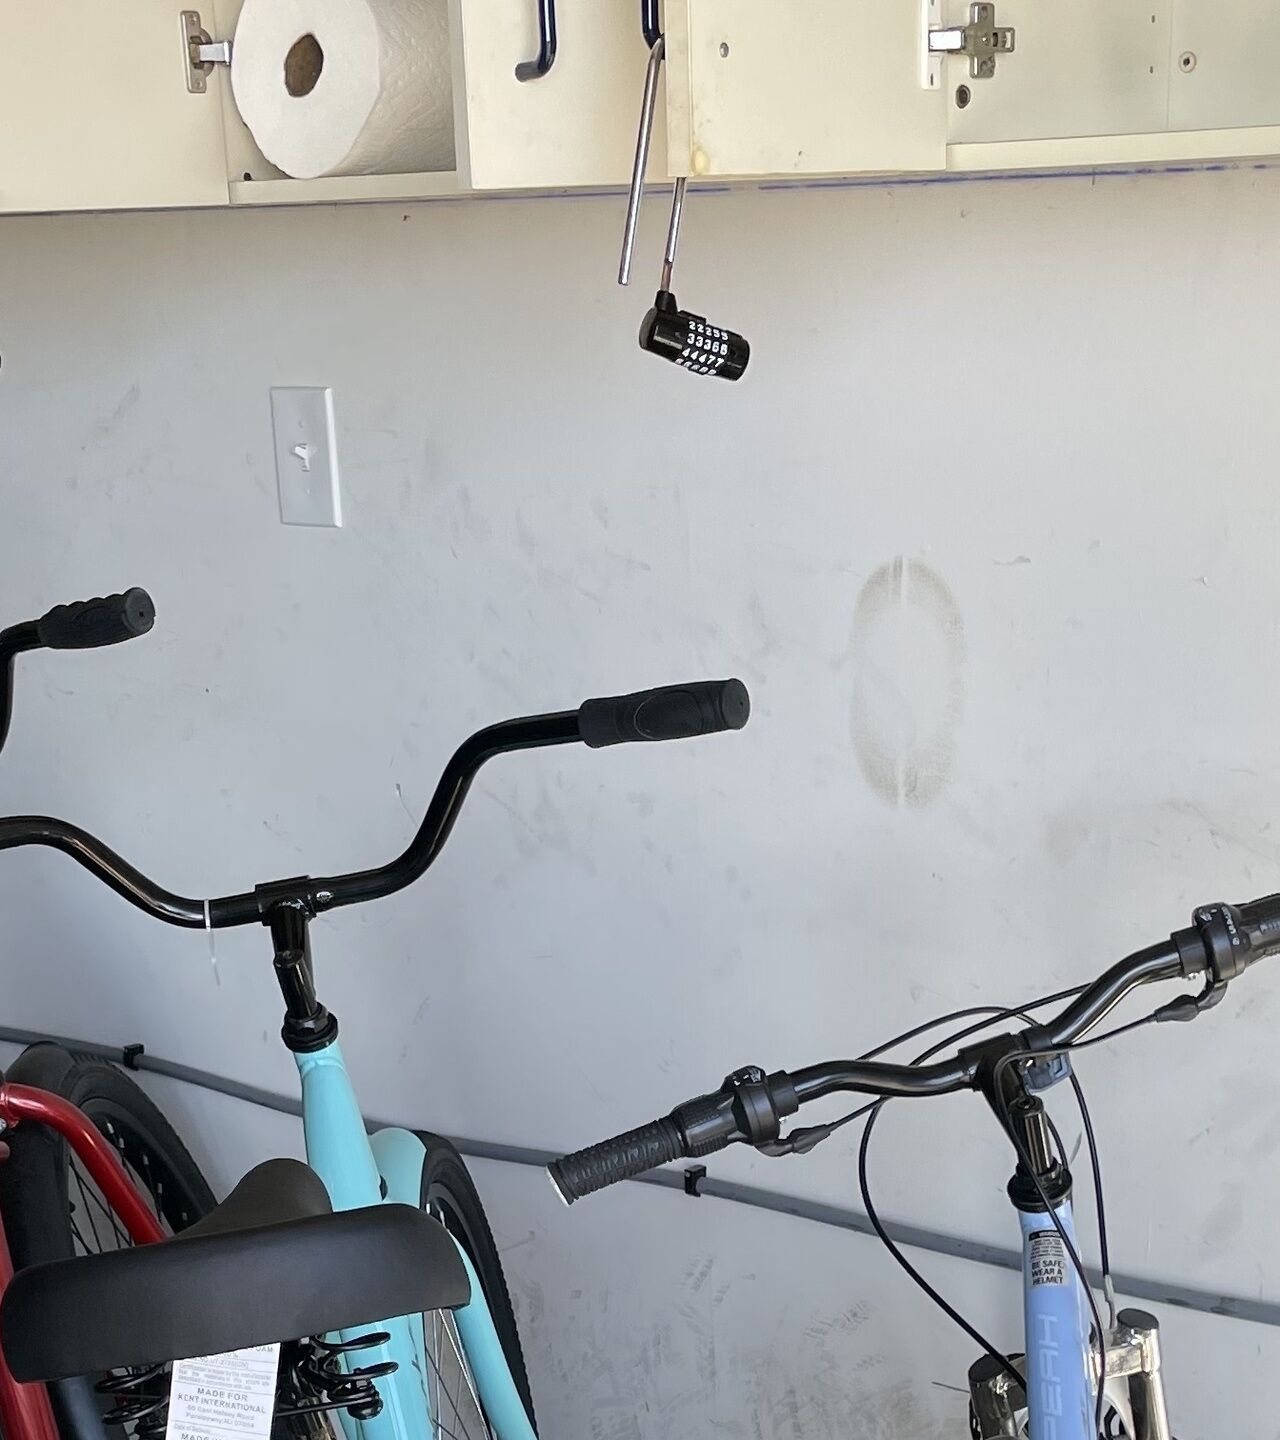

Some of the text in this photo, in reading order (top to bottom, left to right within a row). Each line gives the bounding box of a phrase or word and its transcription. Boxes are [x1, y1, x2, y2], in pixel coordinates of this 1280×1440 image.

[1042, 1259, 1064, 1268] SAFE
[1031, 1268, 1055, 1278] WEAR
[1032, 1276, 1063, 1286] HELMET
[197, 1387, 248, 1401] MADE FOR
[177, 1393, 266, 1414] KENT INTERNATIONAL
